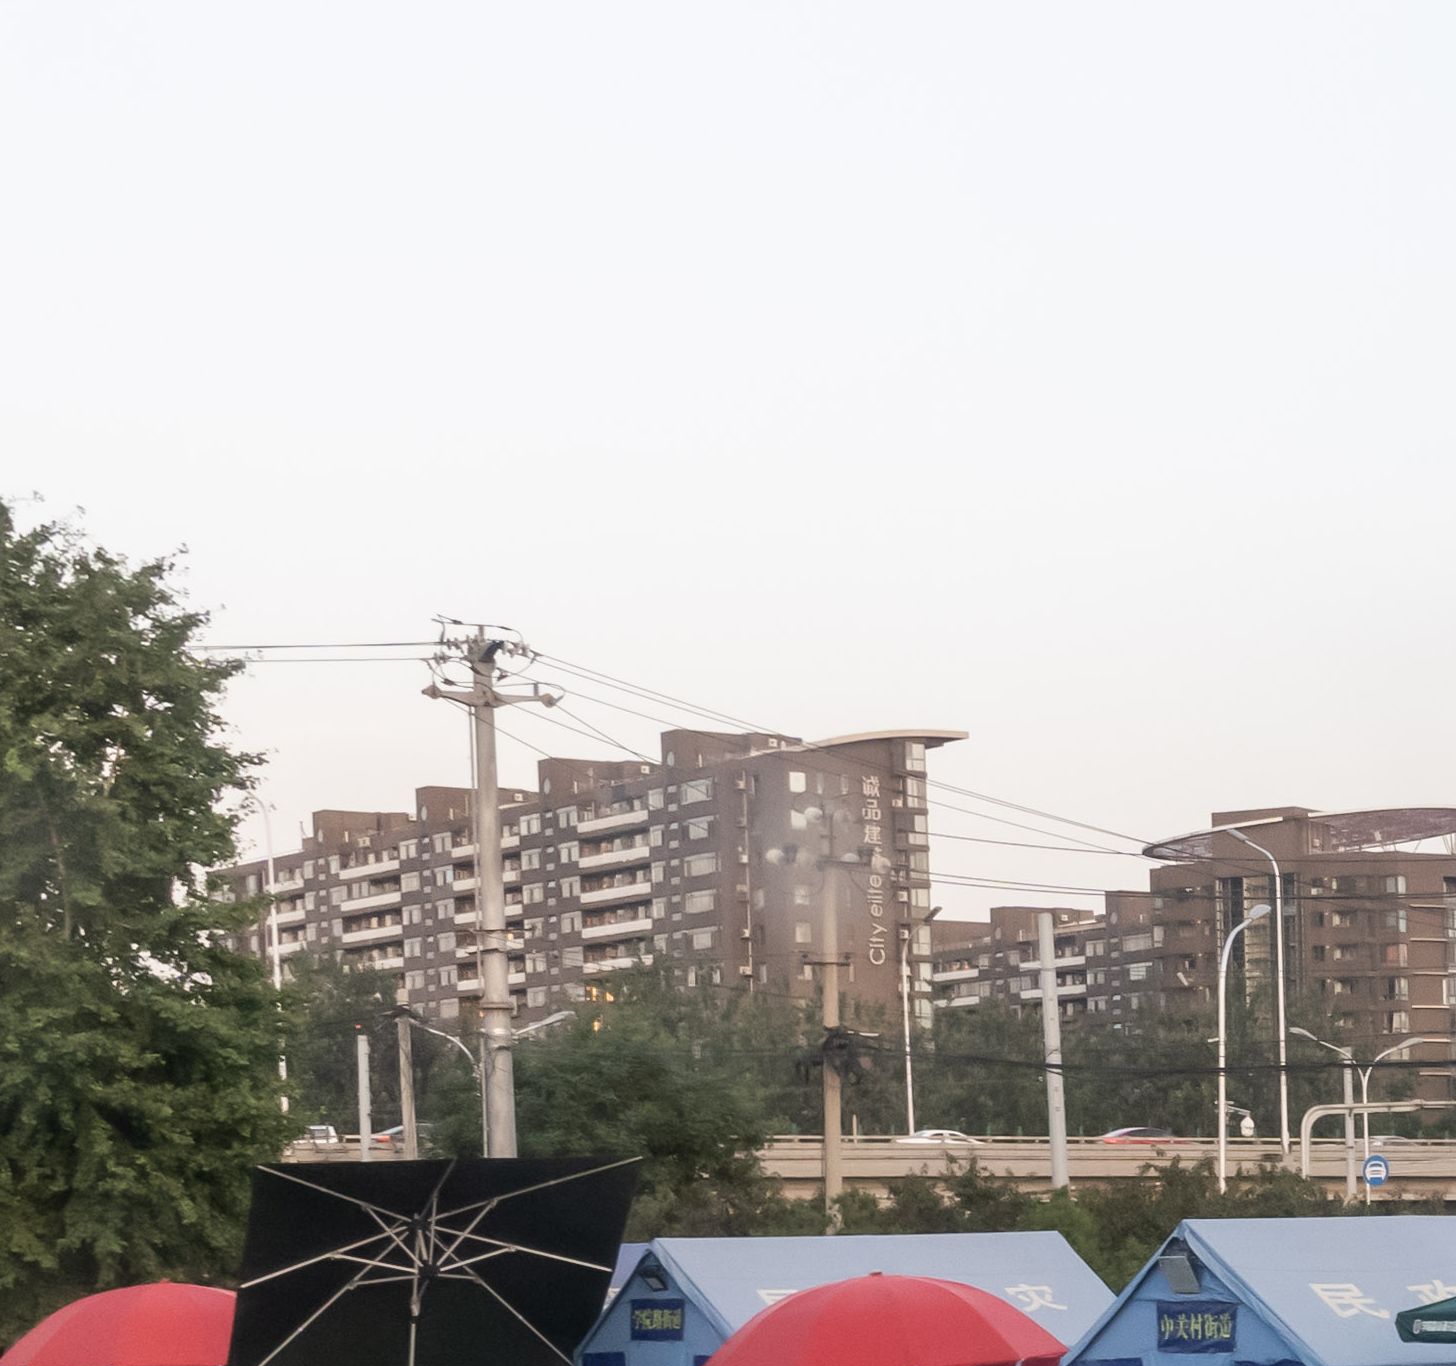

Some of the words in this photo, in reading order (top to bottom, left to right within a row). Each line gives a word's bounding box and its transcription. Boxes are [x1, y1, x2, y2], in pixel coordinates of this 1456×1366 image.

[1160, 1312, 1232, 1341] 中关村街道
